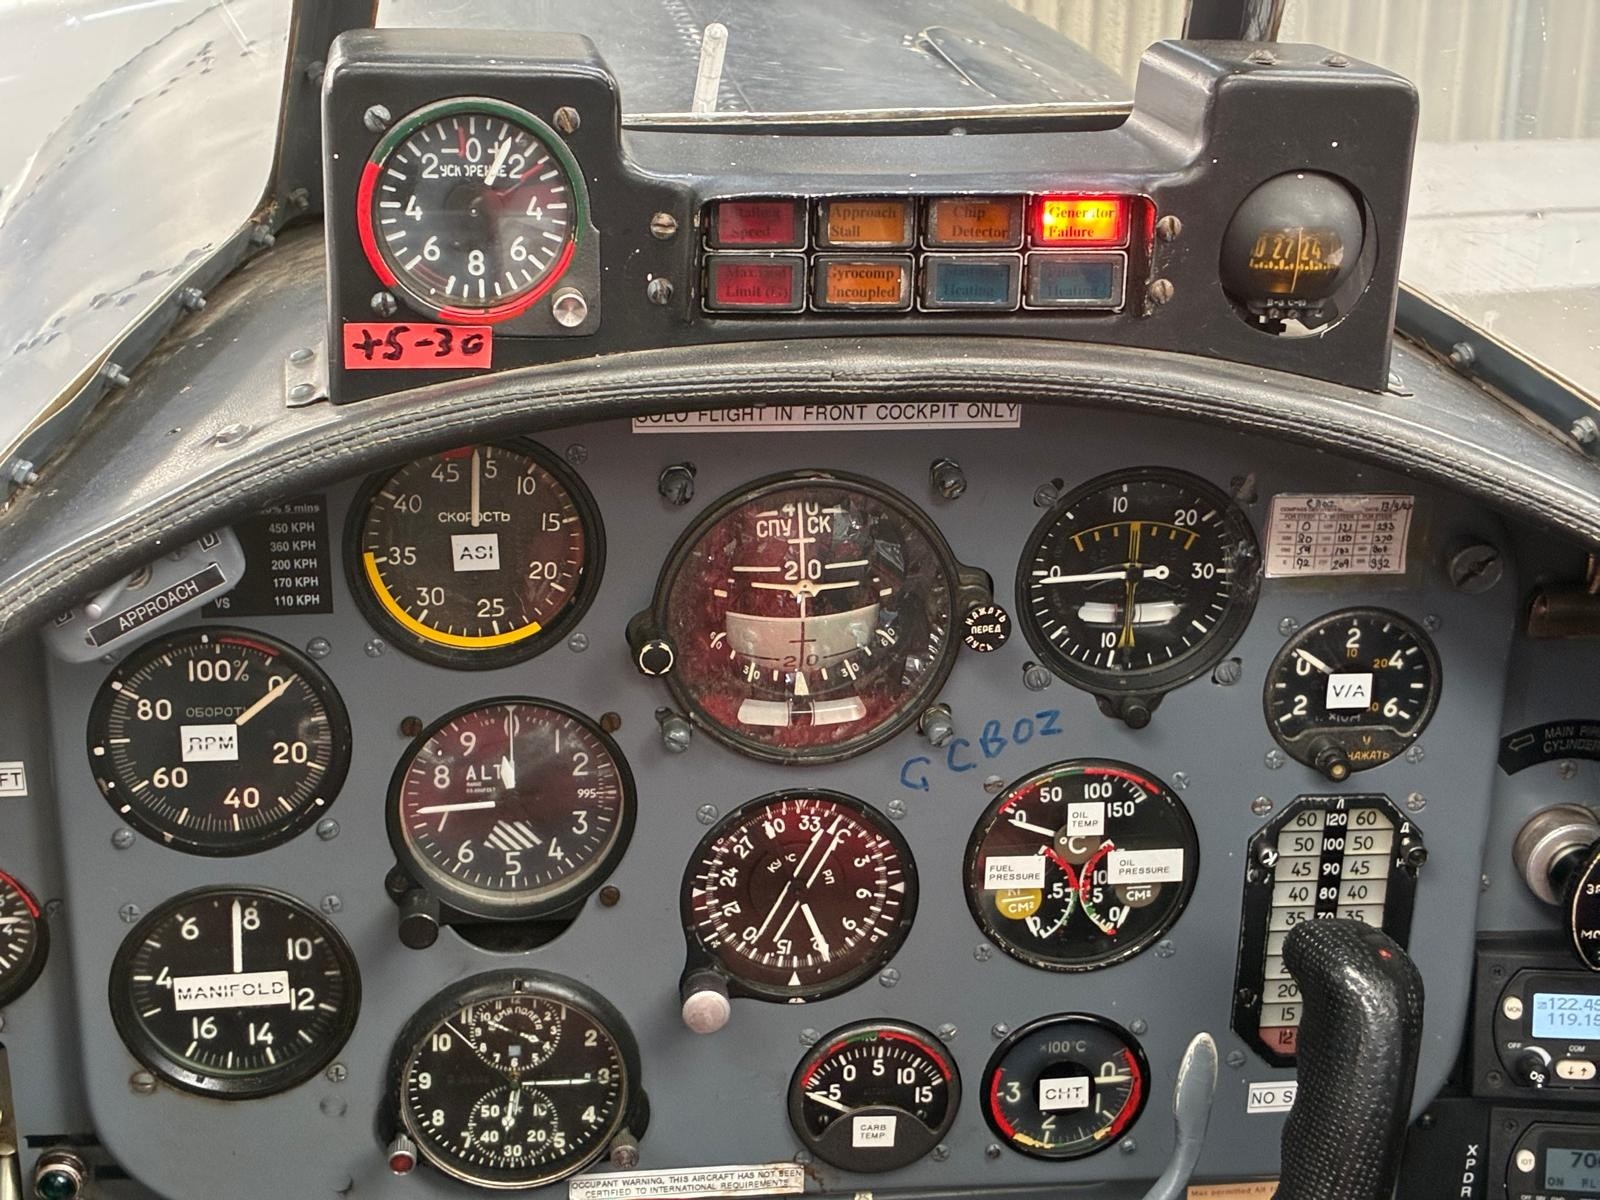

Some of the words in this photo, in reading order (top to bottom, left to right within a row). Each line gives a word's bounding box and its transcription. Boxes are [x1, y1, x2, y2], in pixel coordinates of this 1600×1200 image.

[832, 205, 896, 220] Approach
[953, 204, 985, 220] Chip
[831, 226, 860, 238] Stall
[952, 225, 1009, 238] Detector
[1048, 226, 1094, 238] Failure
[423, 236, 440, 260] 6
[510, 236, 526, 260] 6
[468, 250, 486, 276] 8
[832, 268, 894, 284] yrocomp
[698, 406, 766, 423] FLIGHT
[774, 406, 794, 422] IN
[804, 404, 866, 421] FRONT
[876, 404, 959, 420] COCKPIT
[966, 402, 1018, 419] ONLY
[430, 463, 460, 482] 45
[485, 460, 498, 479] 5
[516, 476, 536, 496] 10
[297, 502, 320, 512] mins
[394, 494, 422, 514] 40
[1112, 497, 1128, 514] 10
[541, 512, 560, 532] 15
[1174, 509, 1198, 526] 20
[269, 522, 288, 533] 450
[292, 522, 316, 532] KPH
[756, 516, 832, 538] СПУСК
[270, 541, 290, 552] 360
[293, 540, 316, 551] KPH
[460, 545, 494, 560] ASI
[272, 560, 290, 570] 200
[294, 559, 318, 570] KPH
[388, 546, 417, 566] 35
[528, 561, 558, 580] 20
[1191, 562, 1215, 580] 30
[273, 578, 292, 588] 170
[295, 577, 319, 588] KPH
[214, 598, 230, 610] VS
[274, 596, 293, 606] 110
[296, 595, 320, 606] KPH
[416, 587, 445, 606] 30
[118, 580, 200, 631] APPROACH
[476, 598, 505, 618] 25
[970, 624, 1002, 634] ПЕРЕД
[1101, 632, 1116, 648] 10
[1346, 628, 1361, 648] 2
[1388, 650, 1404, 670] 4
[188, 660, 250, 682] 100%
[1332, 684, 1365, 698] V/A
[137, 699, 172, 721] 80
[1292, 695, 1308, 716] 2
[1383, 697, 1398, 718] 6
[1544, 726, 1574, 740] MAIN
[187, 736, 234, 752] RPM
[460, 731, 476, 757] 9
[273, 742, 308, 765] 20
[466, 764, 502, 781] ALT
[572, 752, 590, 776] 2
[153, 767, 188, 788] 60
[434, 764, 450, 789] 8
[224, 787, 260, 808] 40
[577, 788, 596, 798] 995
[1040, 786, 1062, 804] 50
[1084, 782, 1112, 800] 100
[1108, 801, 1134, 818] 150
[1356, 810, 1376, 826] 60
[572, 810, 588, 835] 3
[1072, 820, 1098, 828] TEMP
[1296, 812, 1318, 826] 60
[1326, 813, 1347, 826] 120
[548, 837, 564, 861] 4
[1294, 838, 1314, 852] 50
[1322, 838, 1344, 850] 100
[1352, 836, 1374, 850] 50
[458, 840, 474, 864] 6
[506, 852, 522, 876] 5
[989, 864, 1014, 873] FUEL
[1118, 866, 1170, 876] PRESSURE
[1119, 859, 1135, 867] OIL
[1291, 862, 1312, 876] 45
[1322, 863, 1340, 876] 90
[1350, 860, 1370, 874] 45
[1288, 886, 1309, 900] 40
[1318, 887, 1338, 900] 80
[1347, 886, 1368, 900] 40
[243, 908, 260, 930] 8
[1286, 912, 1306, 925] 35
[1346, 910, 1364, 922] 35
[181, 917, 200, 940] 6
[288, 938, 312, 960] 10
[156, 966, 174, 990] 4
[177, 981, 285, 1000] MANIFOLD
[290, 988, 315, 1010] 12
[1278, 984, 1298, 998] 20
[1281, 1007, 1296, 1021] 15
[192, 1016, 218, 1040] 16
[250, 1022, 274, 1046] 14
[432, 1034, 451, 1052] 10
[584, 1030, 598, 1047] 2
[1278, 1030, 1294, 1044] 12
[843, 1064, 856, 1081] 0
[872, 1059, 884, 1076] 5
[897, 1068, 916, 1084] 10
[418, 1072, 432, 1090] 9
[914, 1086, 933, 1103] 15
[1006, 1082, 1020, 1102] 3
[1045, 1086, 1084, 1100] CHT
[1252, 1092, 1275, 1104] NO
[432, 1110, 445, 1126] 8
[481, 1105, 500, 1118] 50
[582, 1106, 596, 1123] 4
[480, 1130, 500, 1142] 40
[526, 1130, 546, 1142] 20
[504, 1145, 522, 1157] 30
[572, 1180, 618, 1190] OCCUPANT
[622, 1178, 665, 1186] WARNING,
[692, 1173, 734, 1182] AIRCRAFT
[756, 1170, 776, 1178] NOT
[778, 1169, 801, 1178] BEEN
[585, 1188, 632, 1198] CERTIFIED
[635, 1187, 647, 1195] TO
[650, 1184, 716, 1194] INTERNATIONAL
[720, 1180, 789, 1190] REQUIREMENTS
